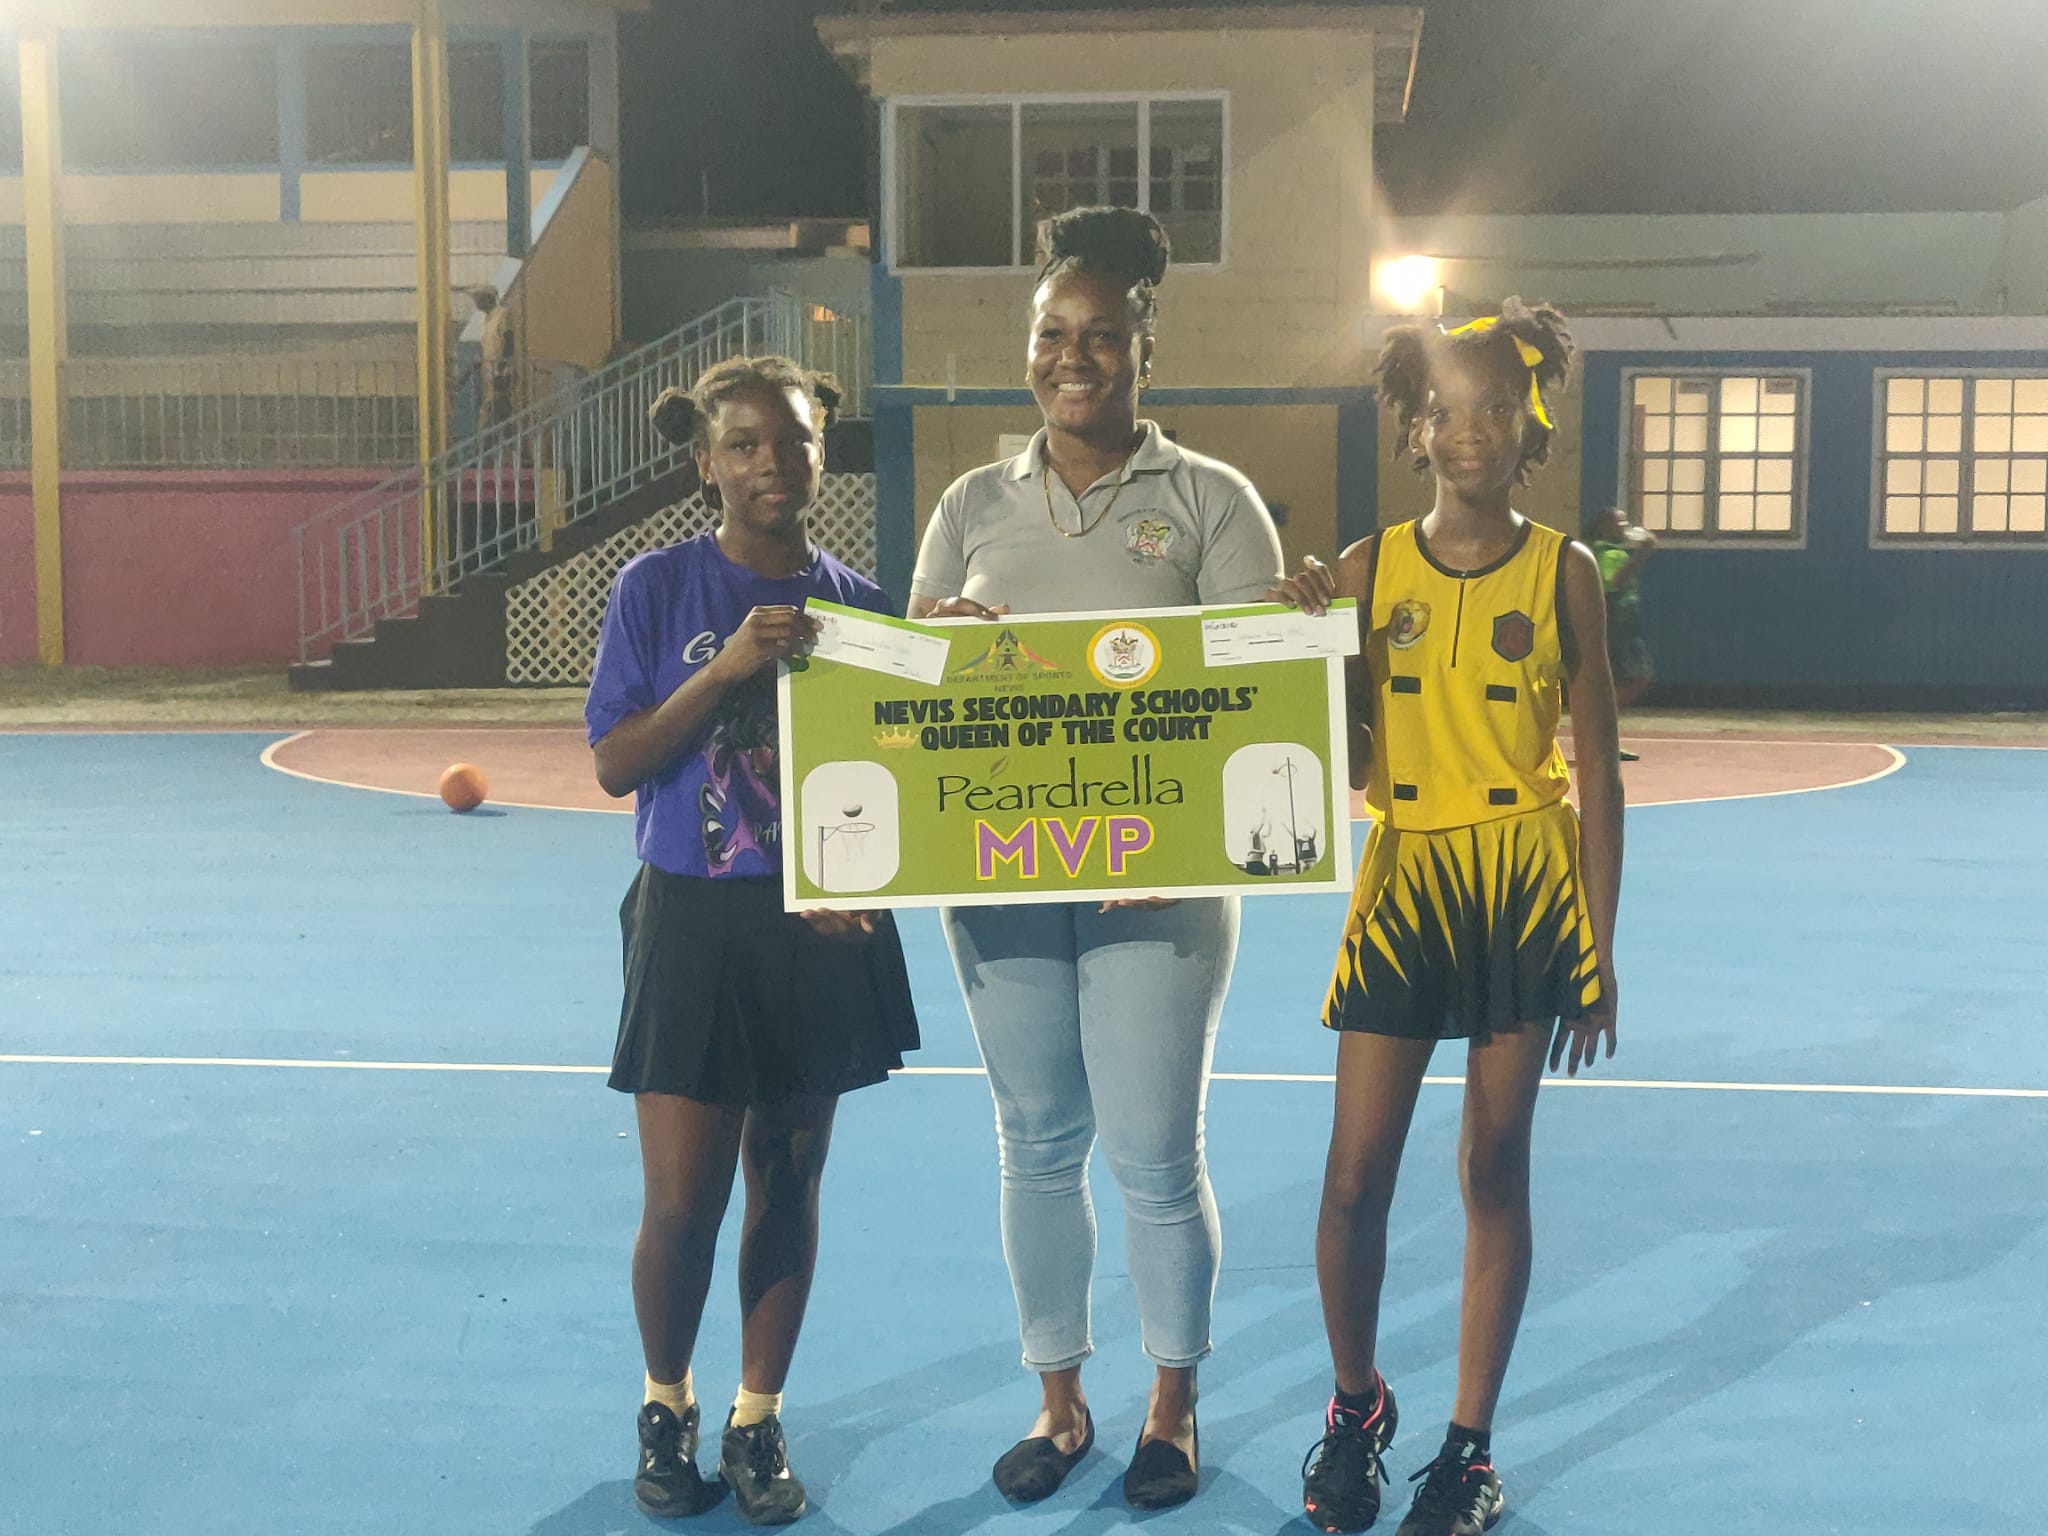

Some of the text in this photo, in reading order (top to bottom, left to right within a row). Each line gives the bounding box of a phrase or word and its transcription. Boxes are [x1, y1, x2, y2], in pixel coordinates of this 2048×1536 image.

[1016, 673, 1028, 681] OF
[874, 699, 955, 725] NEVIS
[963, 692, 1121, 722] SECONDARY
[921, 716, 1212, 750] QUEEN OF THE COURT
[937, 754, 1184, 812] Peardrella
[974, 814, 1155, 880] MVP
